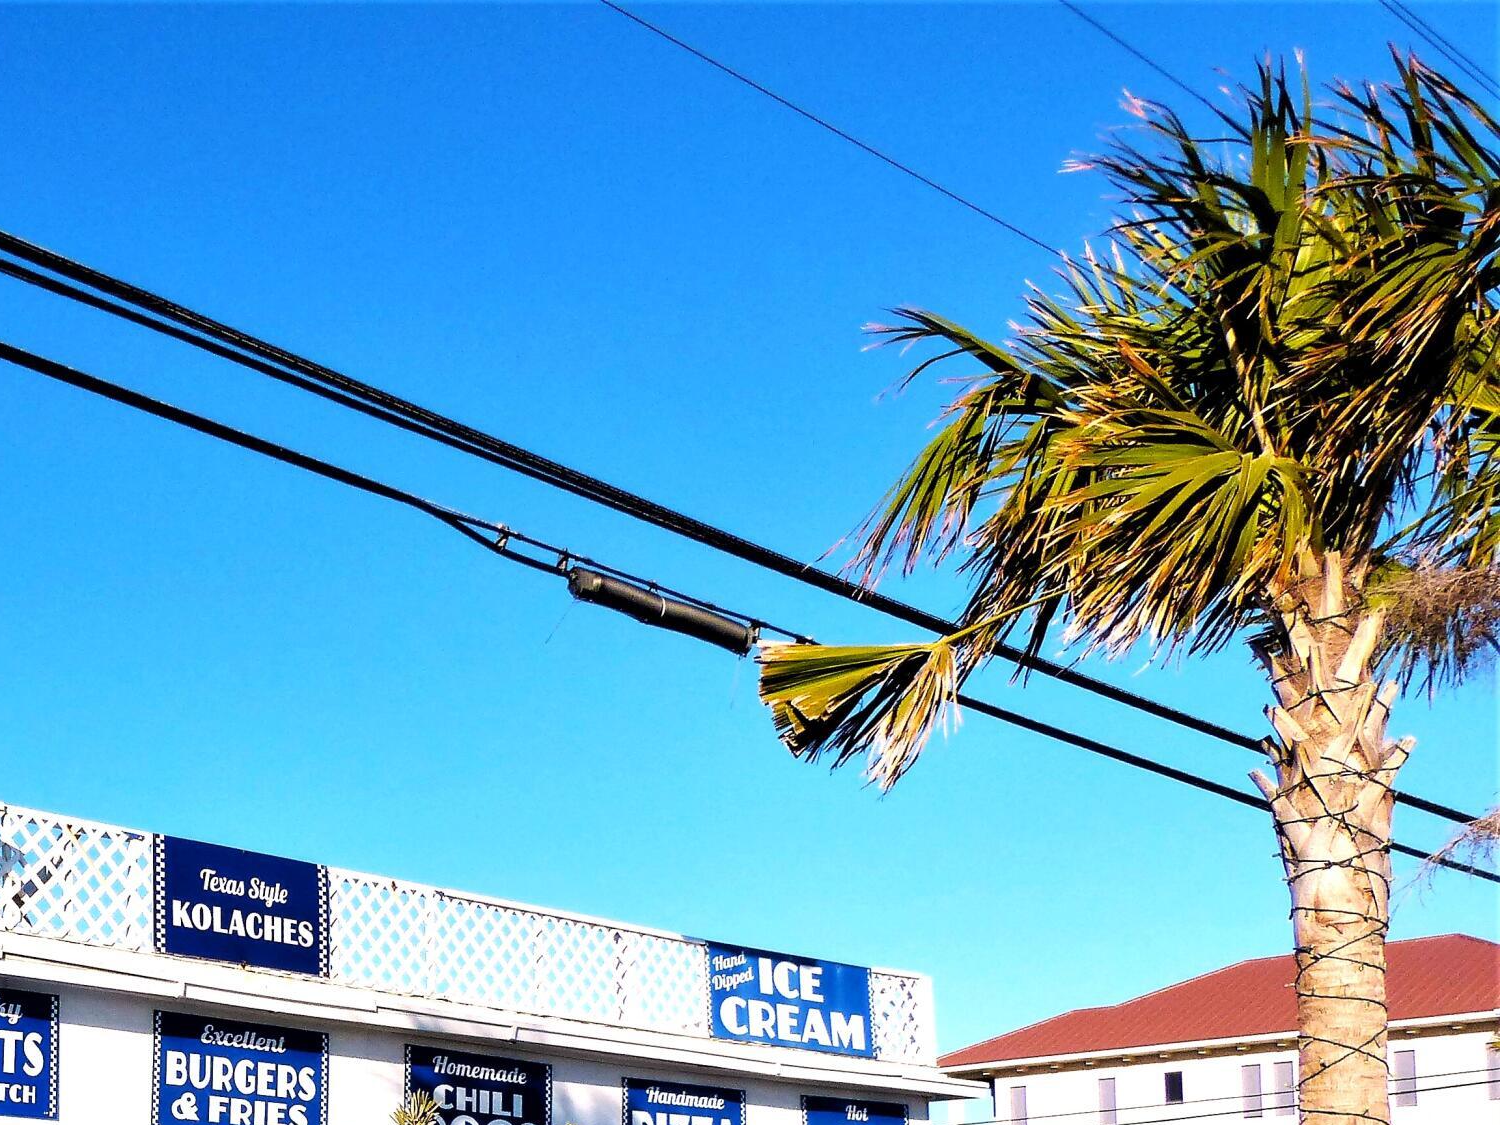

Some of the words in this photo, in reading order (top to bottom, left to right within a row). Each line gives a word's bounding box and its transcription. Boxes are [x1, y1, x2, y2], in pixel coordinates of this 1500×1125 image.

[200, 868, 245, 897] Texas
[248, 876, 289, 907] Style
[172, 899, 314, 948] KOLACHES
[712, 951, 747, 972] Hand
[712, 967, 754, 991] Dipped
[759, 957, 825, 1003] ICE
[200, 1024, 287, 1053] Excellent
[719, 997, 867, 1051] CREAM
[165, 1050, 317, 1102] BURGERS
[432, 1055, 527, 1085] Homemade
[171, 1093, 200, 1121] &
[433, 1084, 523, 1118] CHILI
[645, 1085, 726, 1110] Handmade
[845, 1104, 869, 1122] Hot
